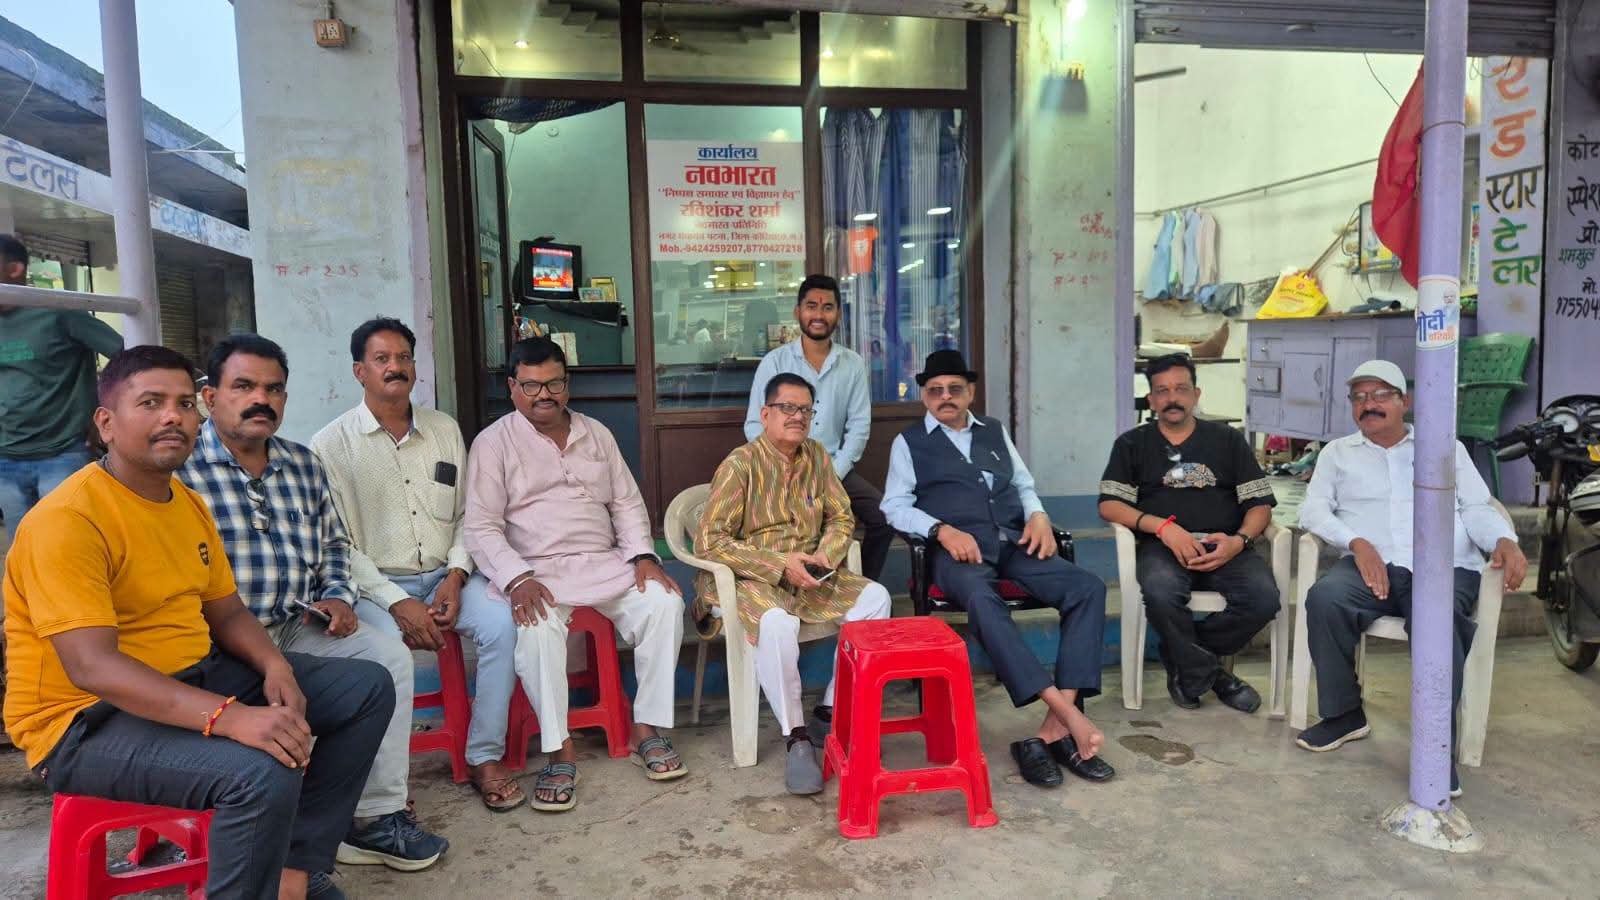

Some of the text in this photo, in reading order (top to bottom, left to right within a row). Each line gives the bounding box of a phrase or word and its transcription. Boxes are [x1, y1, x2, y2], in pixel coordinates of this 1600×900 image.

[697, 144, 759, 159] कार्यालय
[684, 165, 777, 186] नवभारत
[1485, 165, 1543, 213] स्टार
[680, 201, 781, 217] रविशंकर शर्मा
[1555, 296, 1600, 320] 975504
